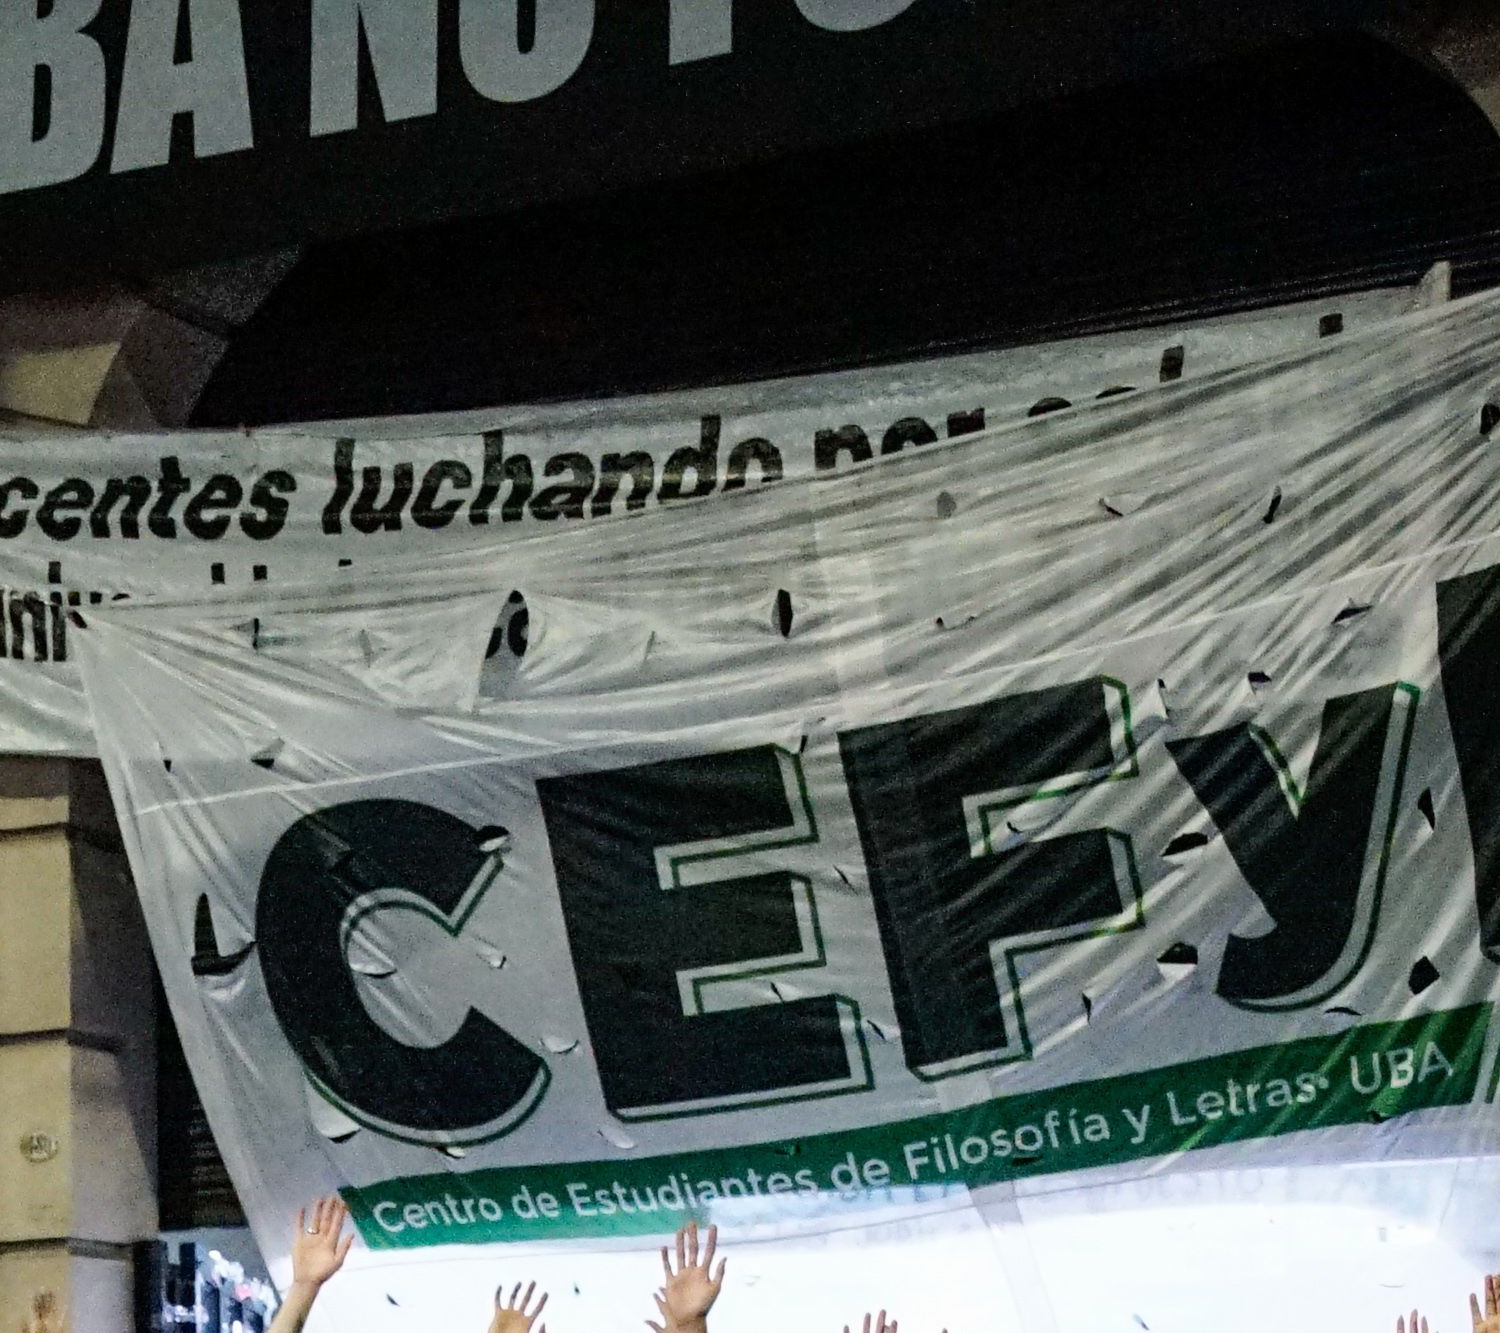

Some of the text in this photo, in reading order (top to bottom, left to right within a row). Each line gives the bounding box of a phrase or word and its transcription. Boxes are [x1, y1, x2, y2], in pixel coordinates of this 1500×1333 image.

[374, 1191, 502, 1233] Centro
[513, 1182, 560, 1219] de
[571, 1167, 819, 1218] Estudiantes
[830, 1152, 891, 1189] de
[903, 1104, 1112, 1180] Filosofía
[1121, 1104, 1151, 1145] y
[1350, 1041, 1455, 1095] UBA
